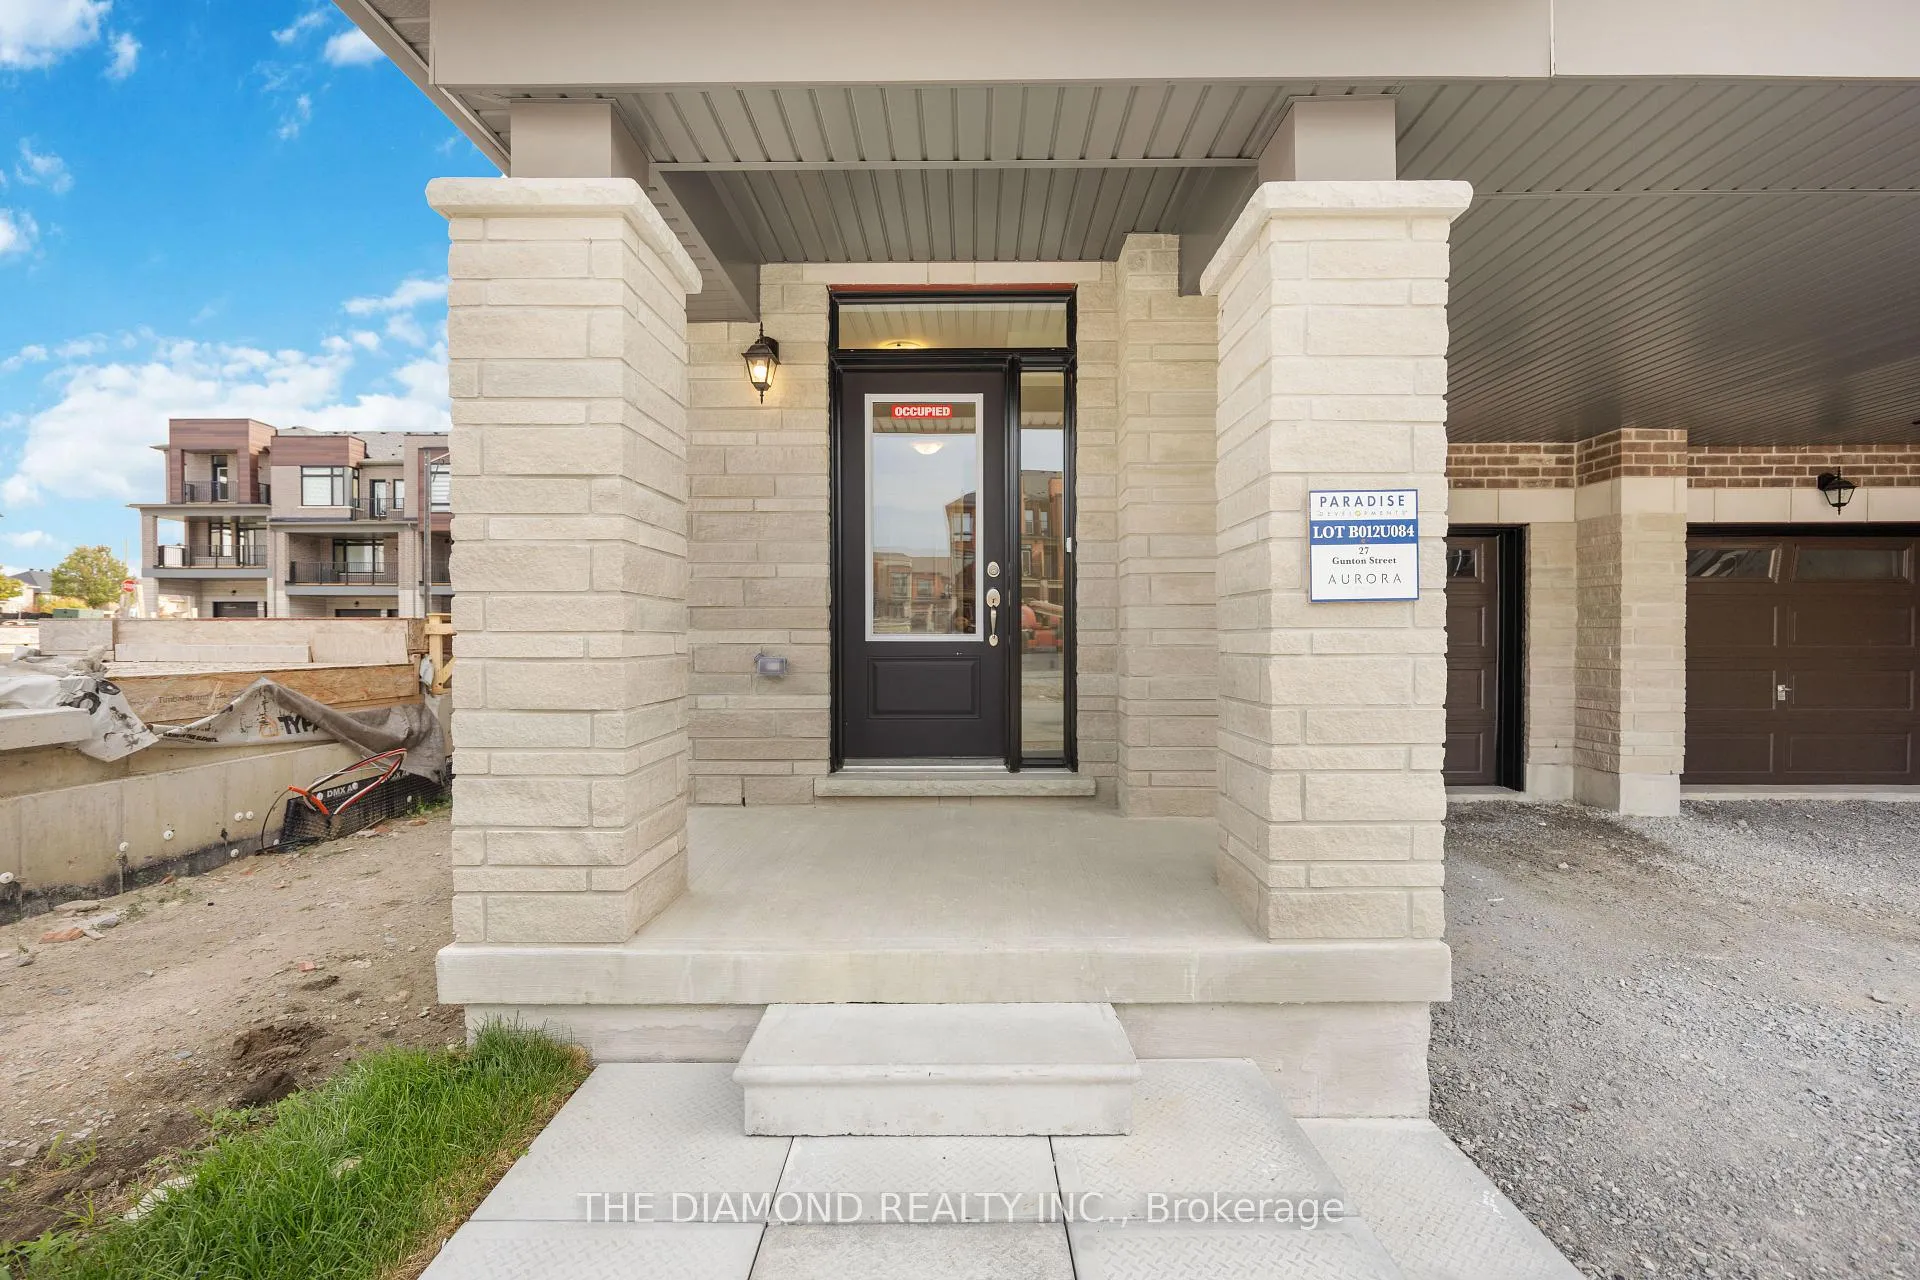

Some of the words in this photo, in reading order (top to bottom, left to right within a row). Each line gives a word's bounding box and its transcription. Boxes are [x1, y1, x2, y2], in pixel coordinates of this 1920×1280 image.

[894, 406, 951, 417] OCCUPIED
[1319, 495, 1406, 508] PARADISE
[1312, 525, 1346, 539] LOT
[1348, 524, 1415, 538] B012U084
[1358, 546, 1370, 555] 27
[1332, 556, 1367, 565] Gunton
[1369, 556, 1397, 565] Street
[1328, 573, 1402, 585] AURORA
[326, 787, 346, 798] DMX
